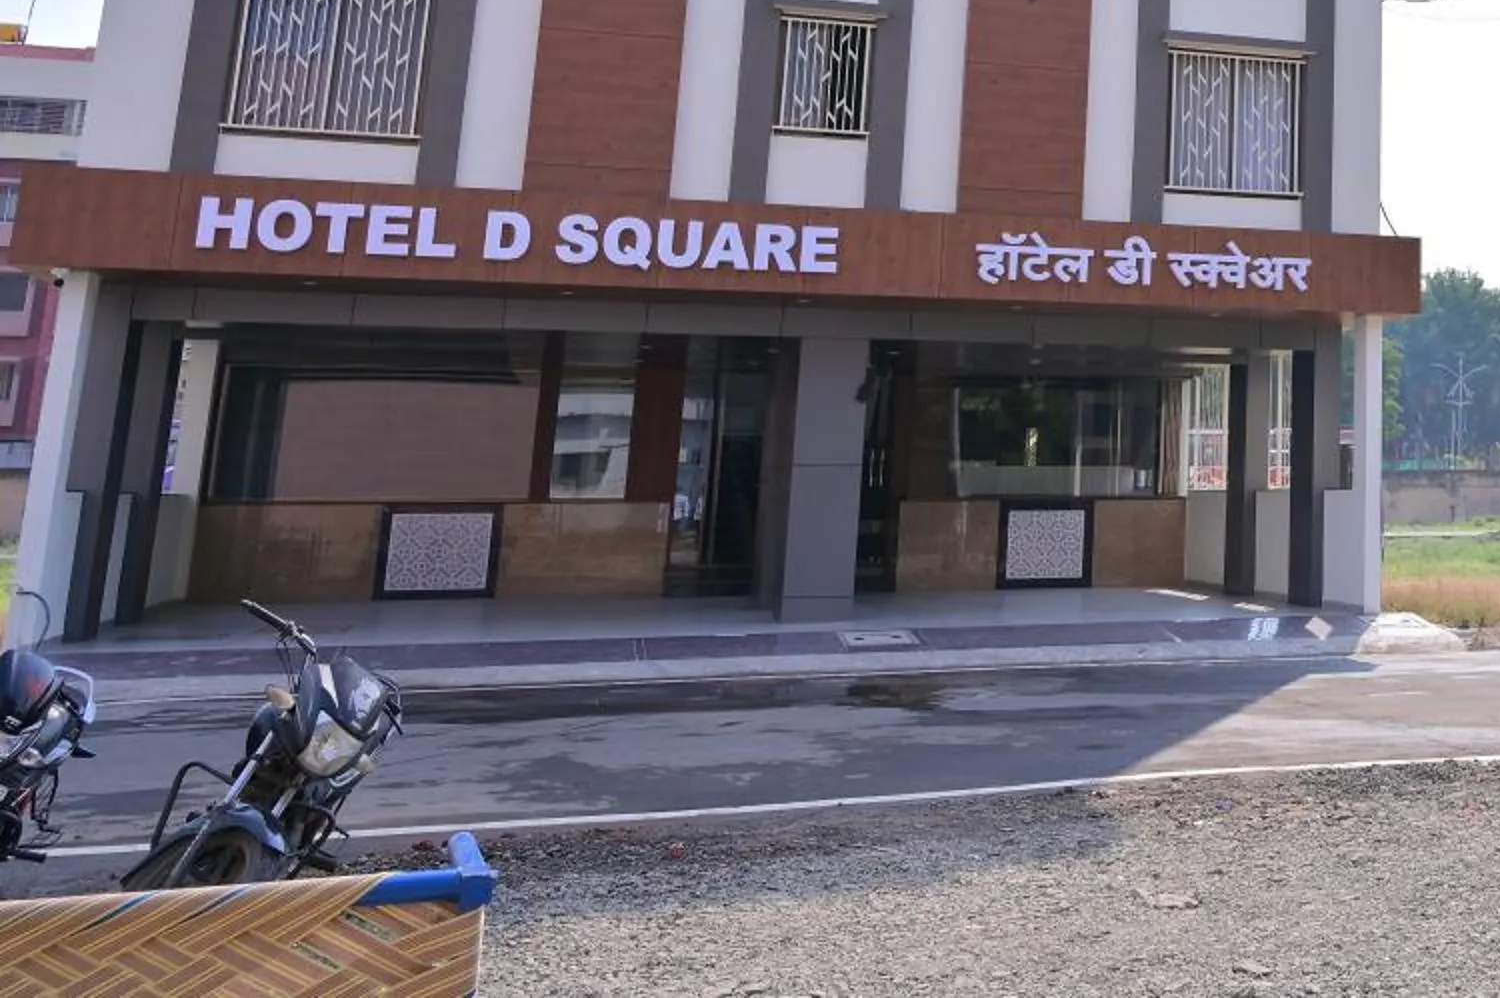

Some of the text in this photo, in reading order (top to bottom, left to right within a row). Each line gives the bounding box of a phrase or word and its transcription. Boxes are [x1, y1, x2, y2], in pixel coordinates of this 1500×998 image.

[195, 195, 840, 274] HOTEL D SQUARE
[976, 232, 1313, 292] हॉटेल डी स्क्वेअर
